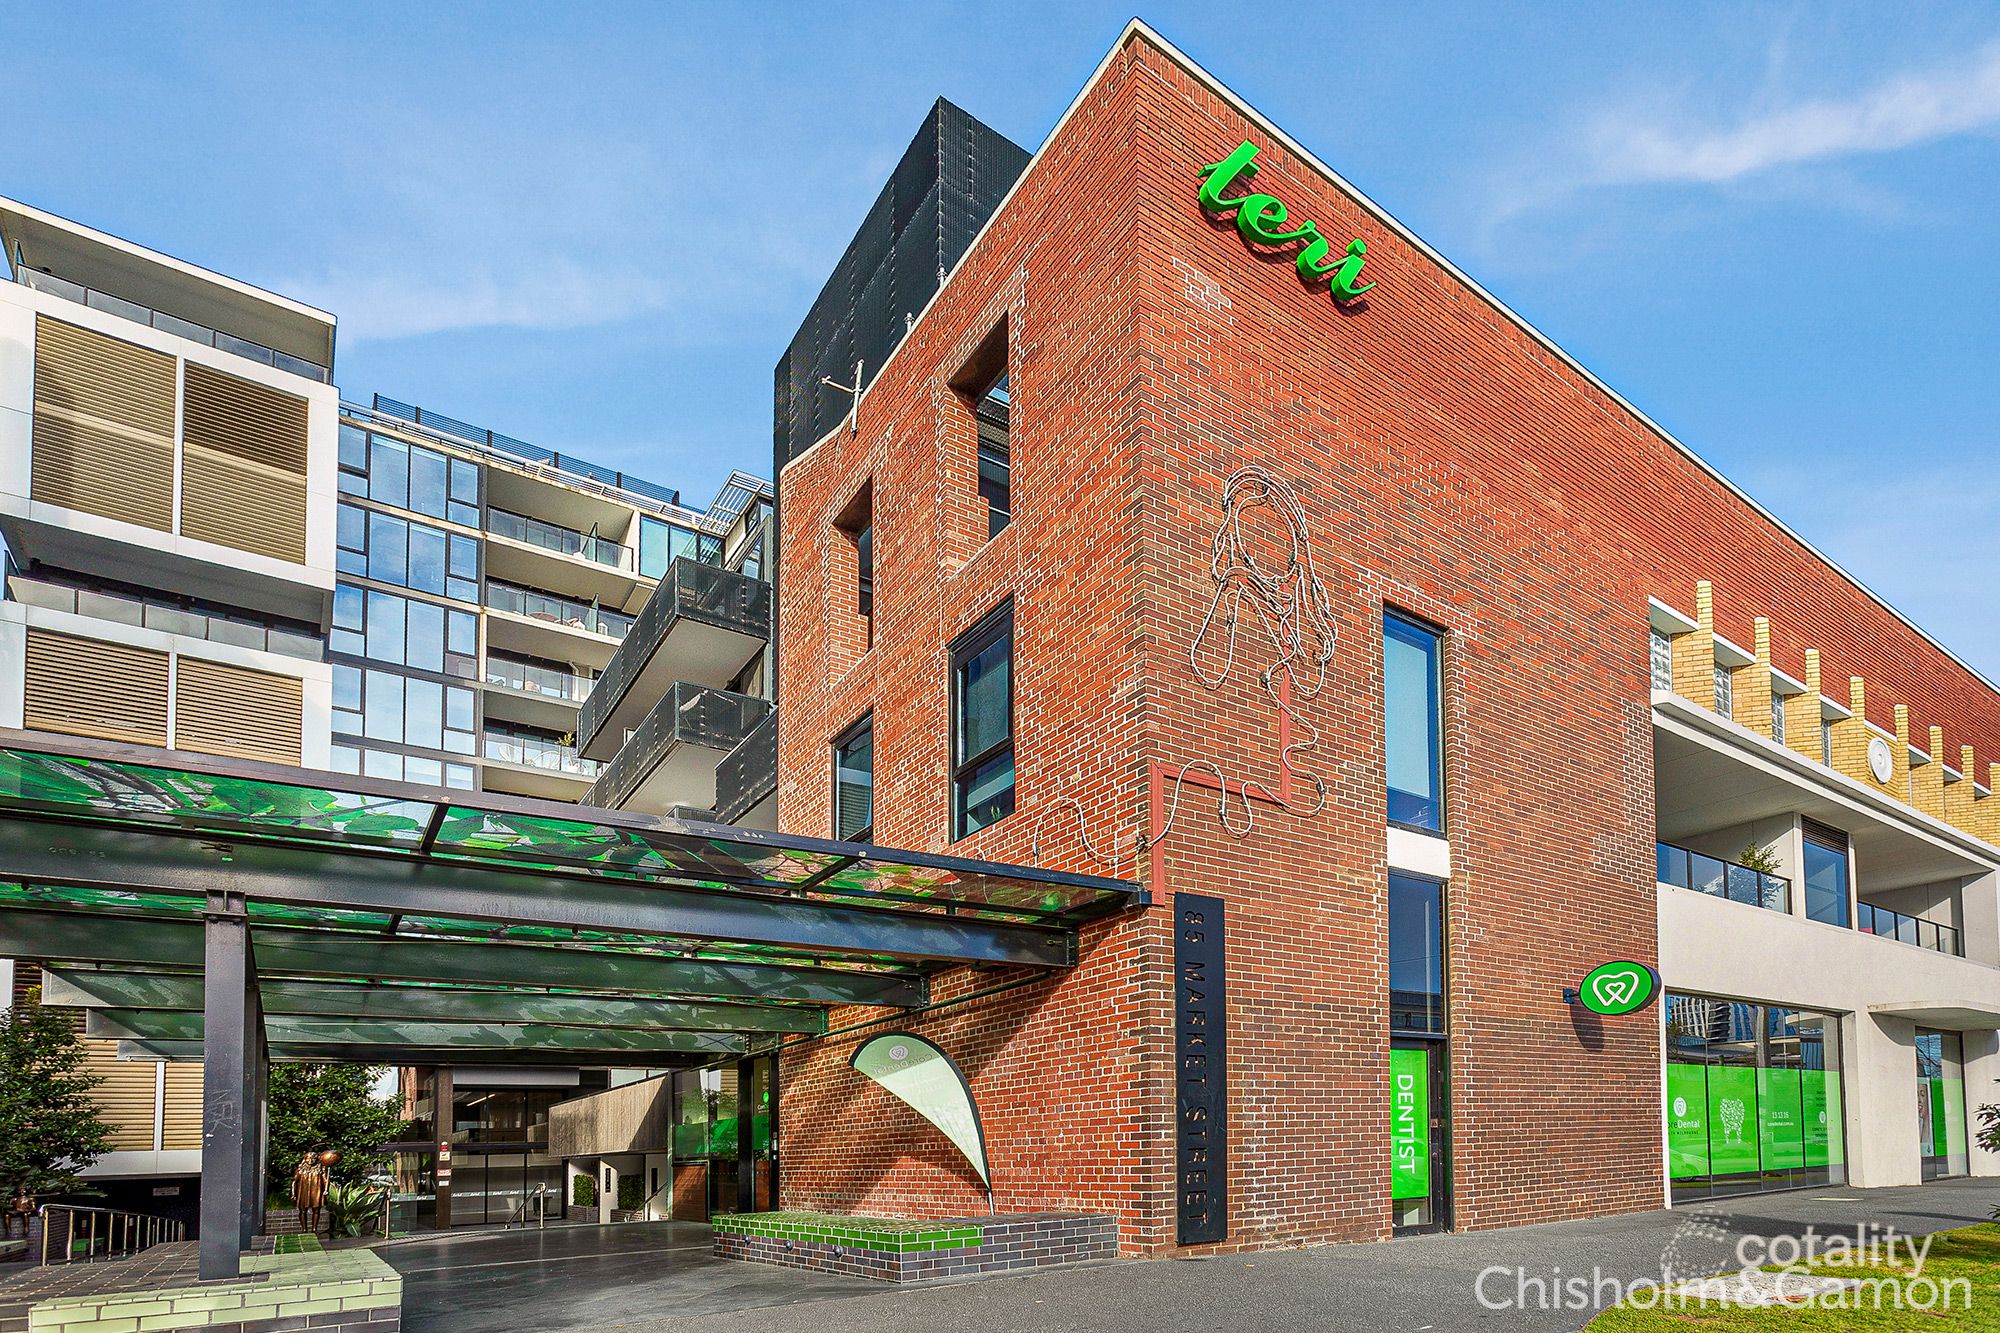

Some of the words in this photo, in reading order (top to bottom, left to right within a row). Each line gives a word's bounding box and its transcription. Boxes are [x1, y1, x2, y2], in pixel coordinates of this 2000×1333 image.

[1197, 140, 1377, 300] teri
[1184, 911, 1205, 944] 85
[1184, 961, 1207, 1088] MARKET
[1185, 1106, 1207, 1224] STREET
[1397, 1074, 1415, 1175] DENTIST
